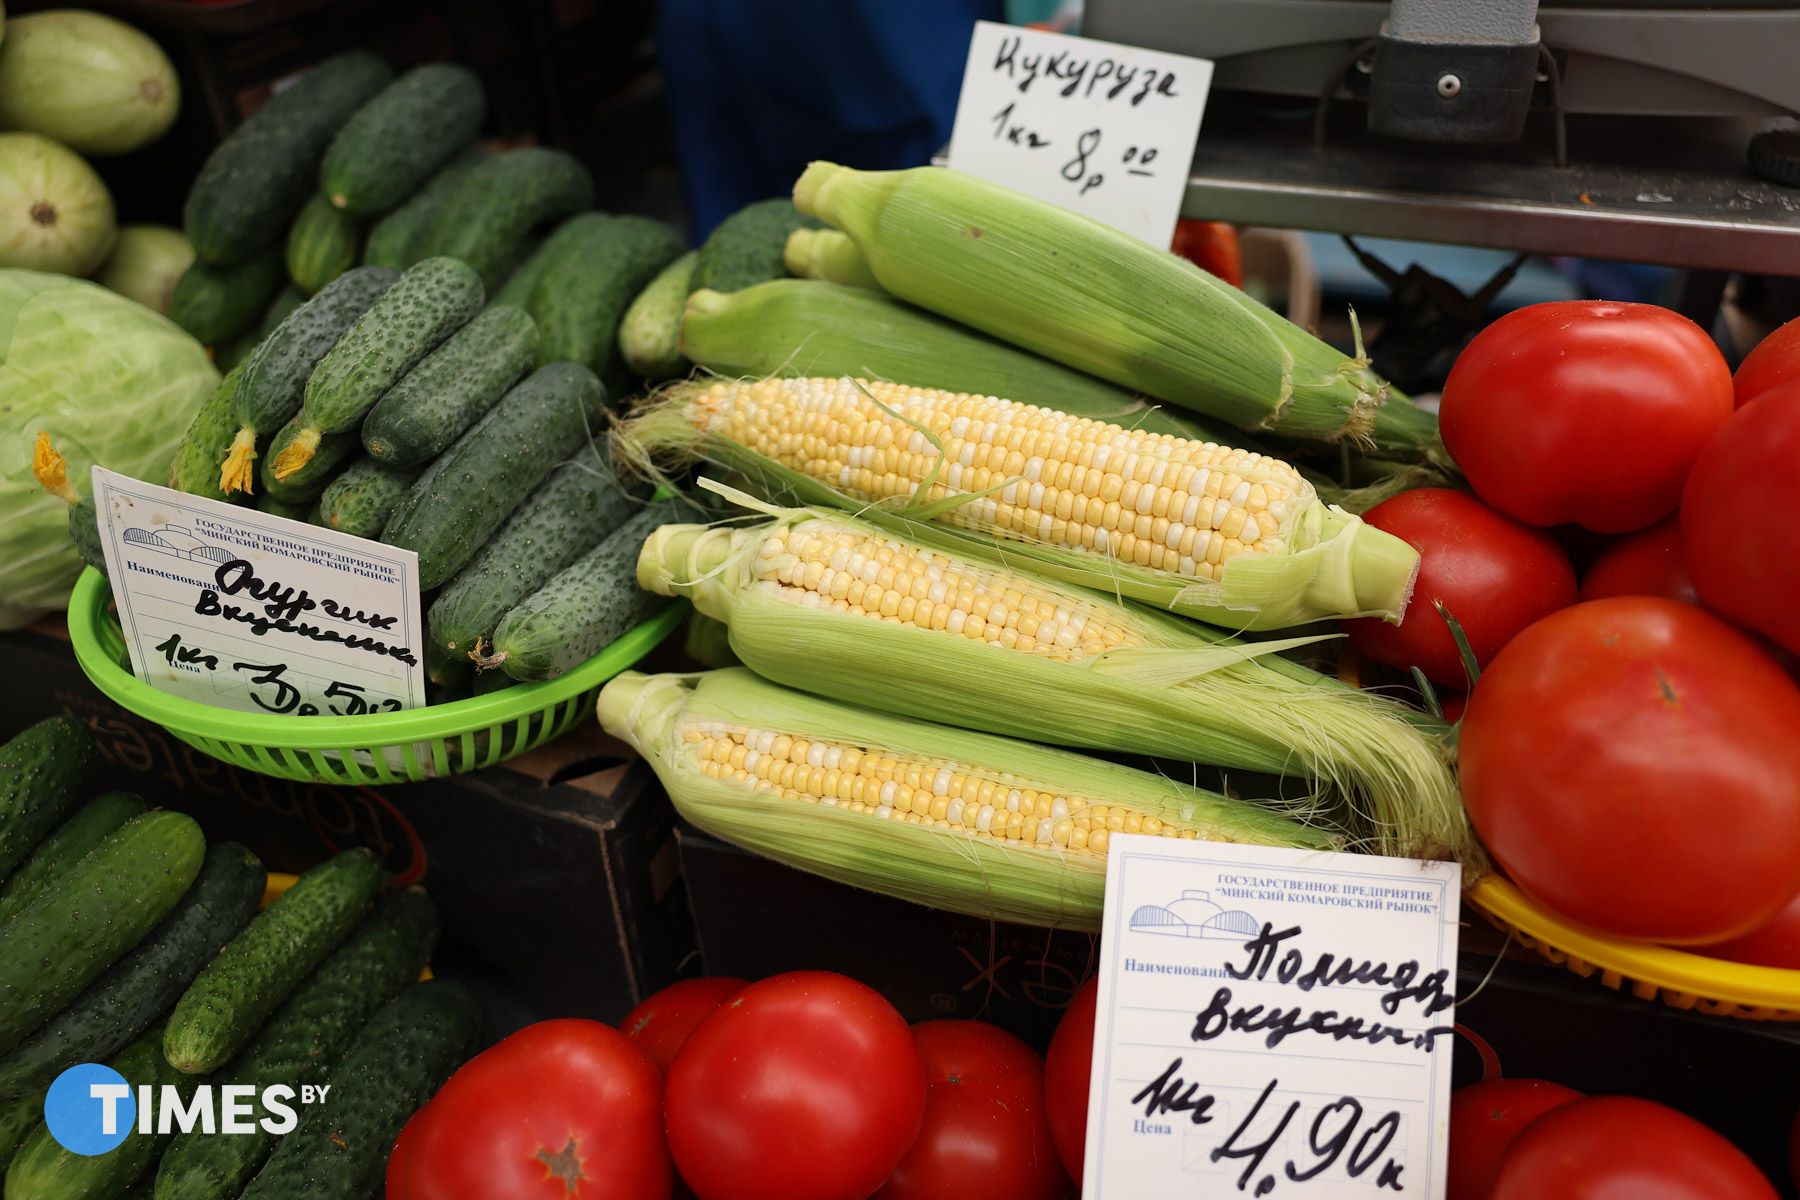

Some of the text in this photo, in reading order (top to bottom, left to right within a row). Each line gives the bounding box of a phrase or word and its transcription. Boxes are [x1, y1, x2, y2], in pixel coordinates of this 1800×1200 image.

[994, 36, 1179, 107] Кукуруза
[992, 102, 1051, 148] 1кг
[195, 518, 396, 576] ГОСУДАРСТВЕННОЕ ПРЕДПРИЯТИЕ
[262, 543, 350, 574] КОМАРОВСКИЙ
[126, 560, 220, 592] Наименовани
[1217, 873, 1433, 902] ГОСУДАРСТВЕННОЕ ПРЕДПРИЯТИЕ
[1287, 892, 1383, 911] КОМАРОВСКИЙ
[1133, 1119, 1172, 1136] Цена
